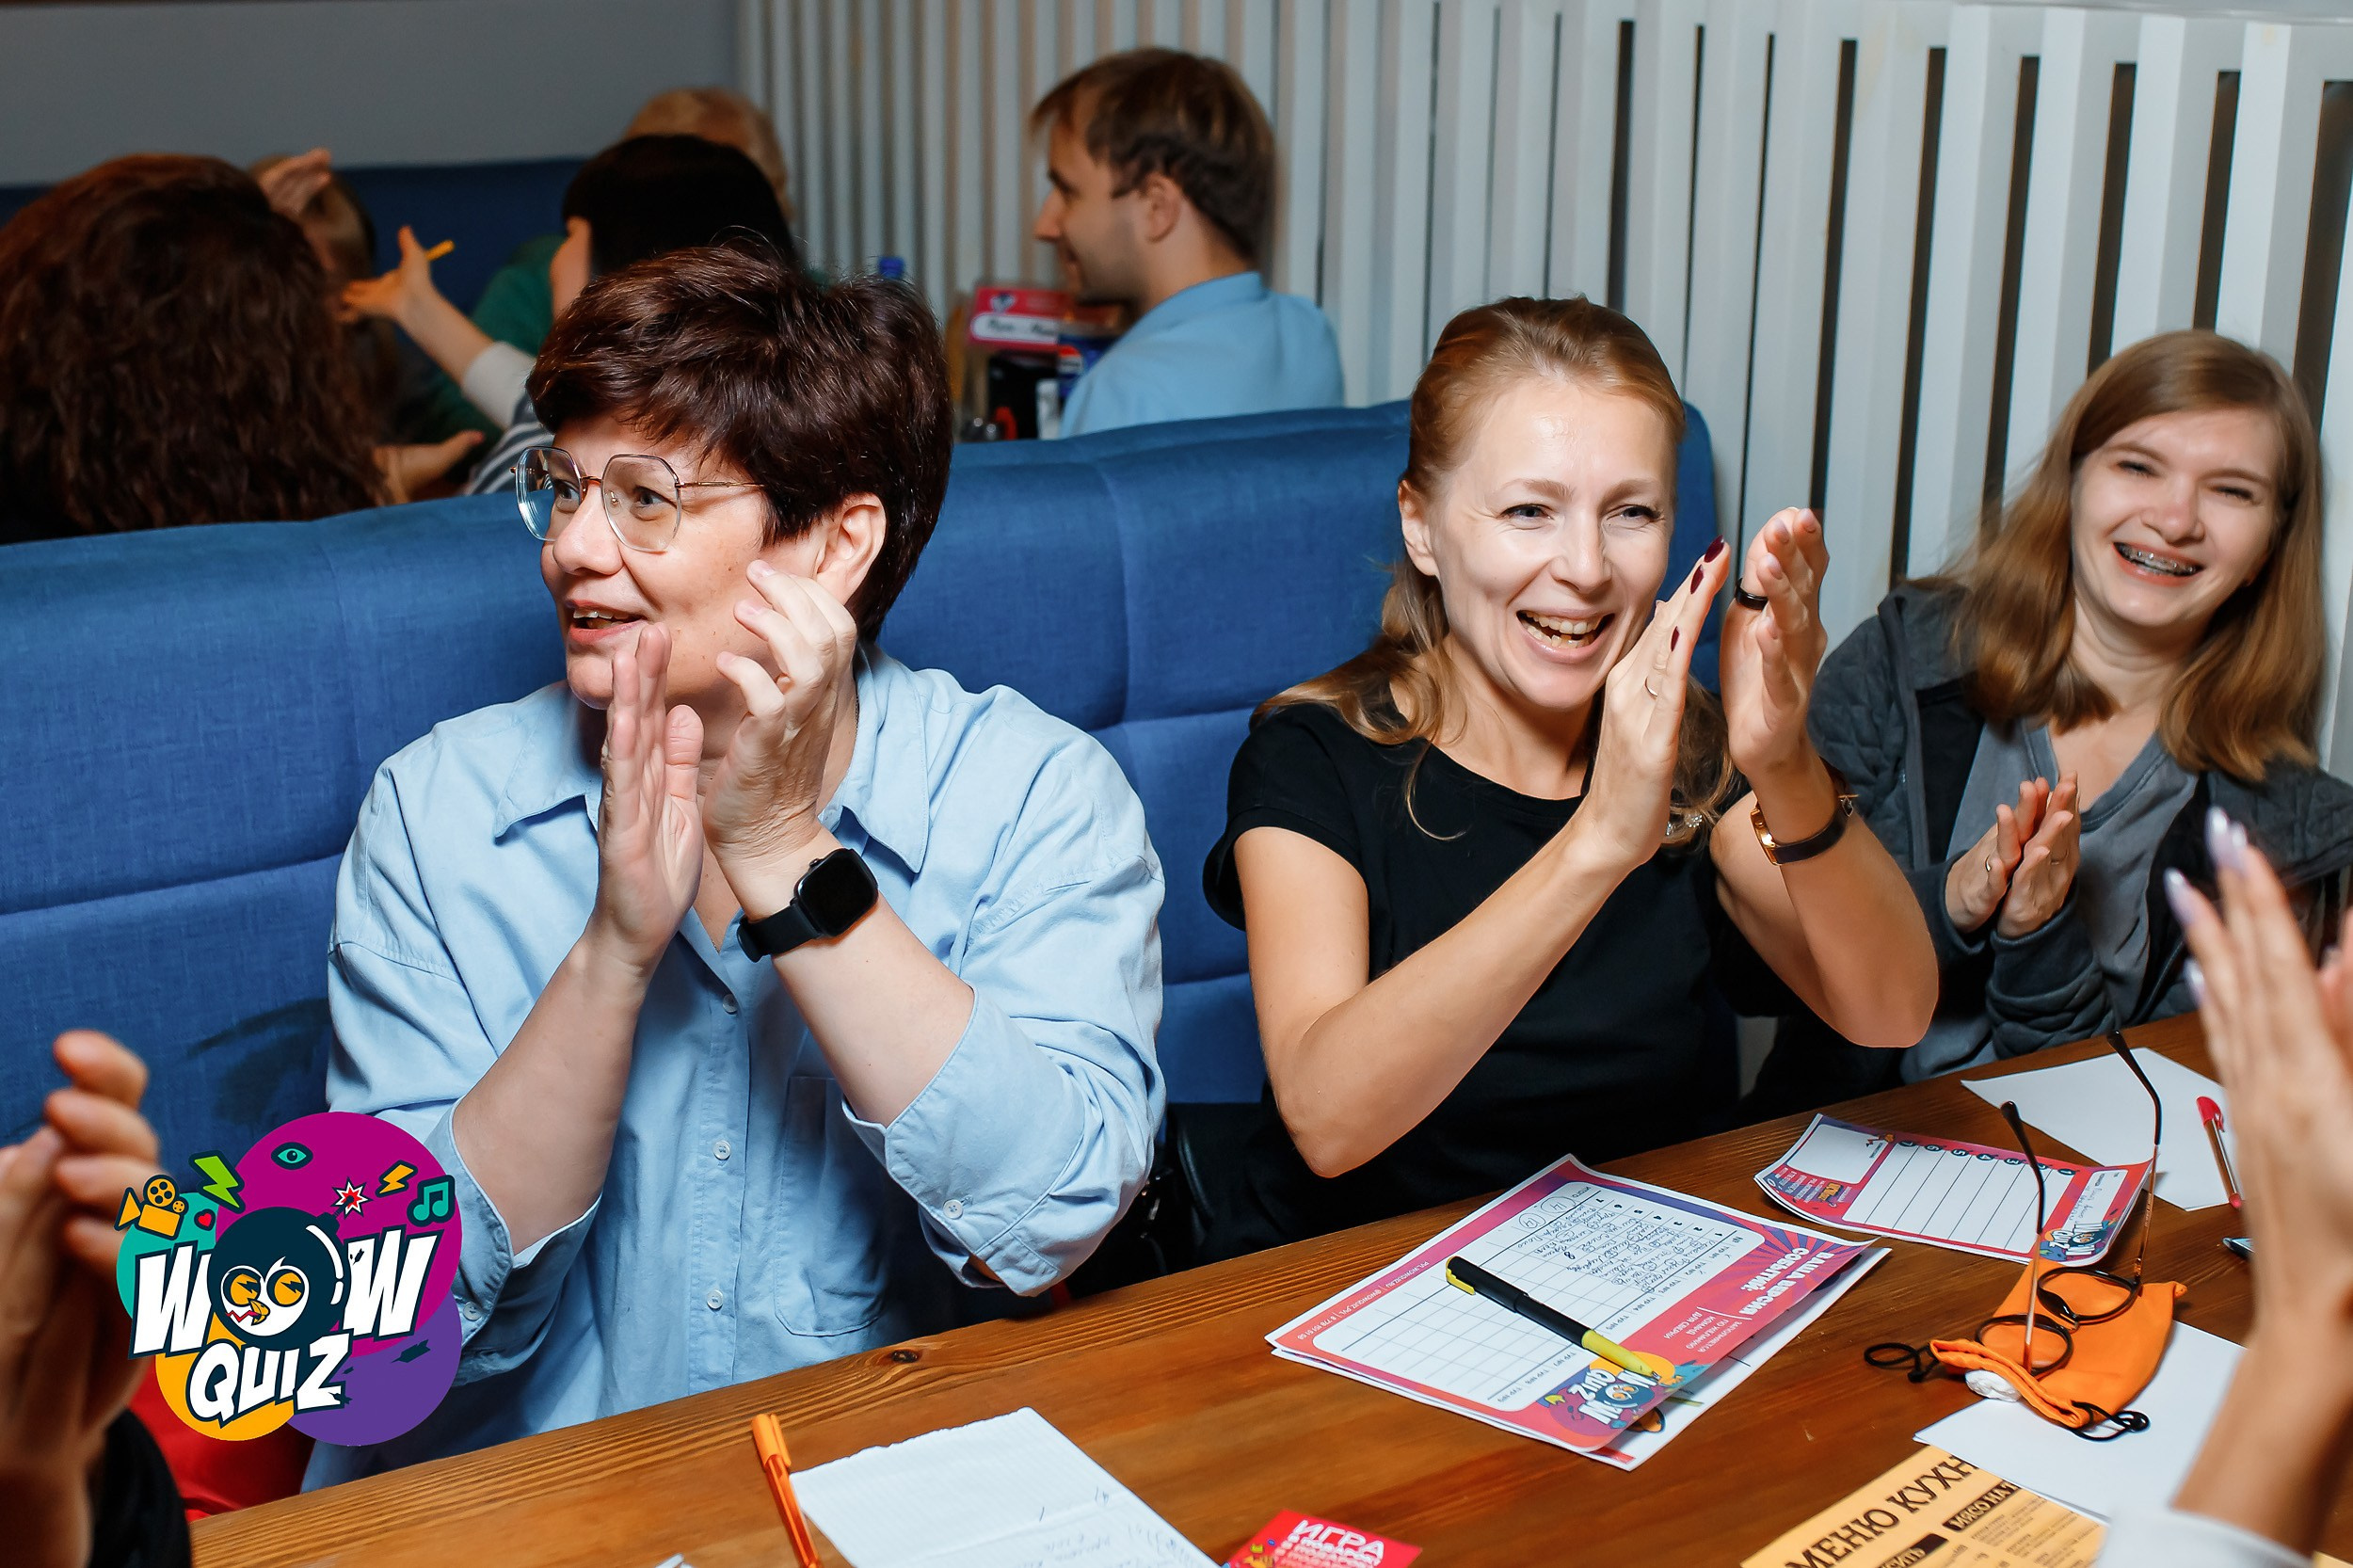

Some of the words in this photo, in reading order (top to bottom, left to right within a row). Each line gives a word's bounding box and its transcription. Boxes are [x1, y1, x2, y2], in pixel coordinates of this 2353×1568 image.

[1572, 1186, 1592, 1197] ИТОГО
[1740, 1248, 1810, 1291] СОБЫТИЙ:
[1785, 1252, 1834, 1279] ВАША
[1738, 1280, 1797, 1315] ВЕРСИЯ
[1686, 1316, 1716, 1335] КОМАНД
[1687, 1311, 1703, 1322] ДЛЯ
[1567, 1368, 1617, 1401] QUIZ
[1785, 1509, 1899, 1568] МЕНЮ
[1885, 1455, 1979, 1513] КУХН
[1950, 1499, 1991, 1529] МЯСО
[1292, 1519, 1385, 1566] ИГРА
